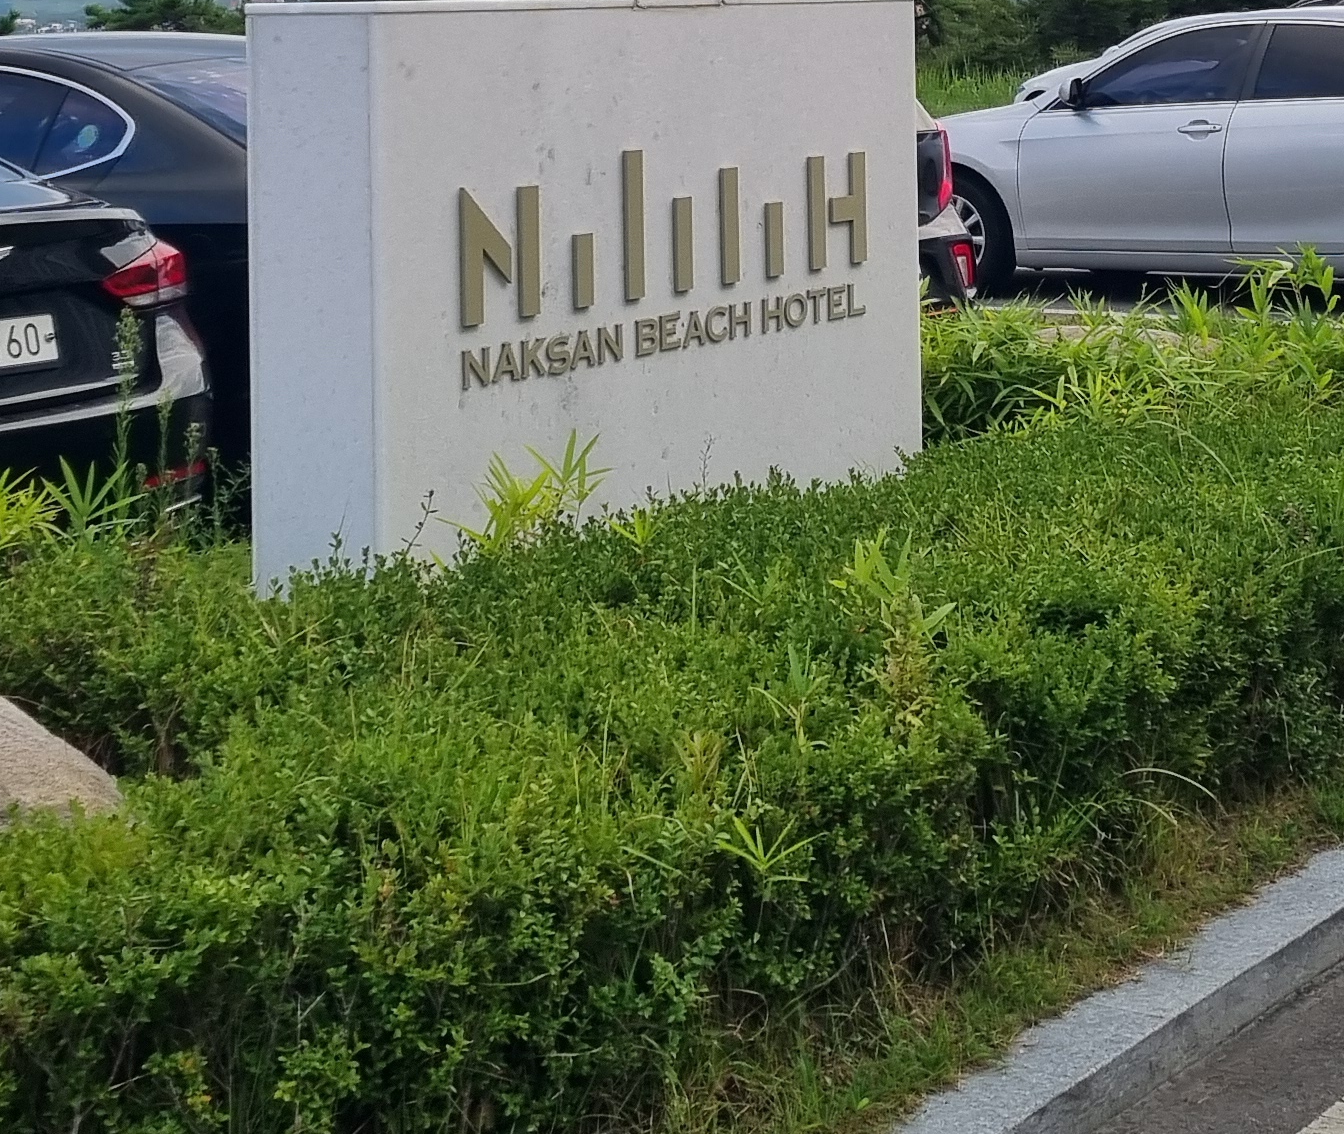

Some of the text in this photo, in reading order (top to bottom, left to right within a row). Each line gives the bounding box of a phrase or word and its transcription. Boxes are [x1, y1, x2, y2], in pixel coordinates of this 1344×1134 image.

[461, 282, 867, 390] NAKSAN BEACH HOTEL
